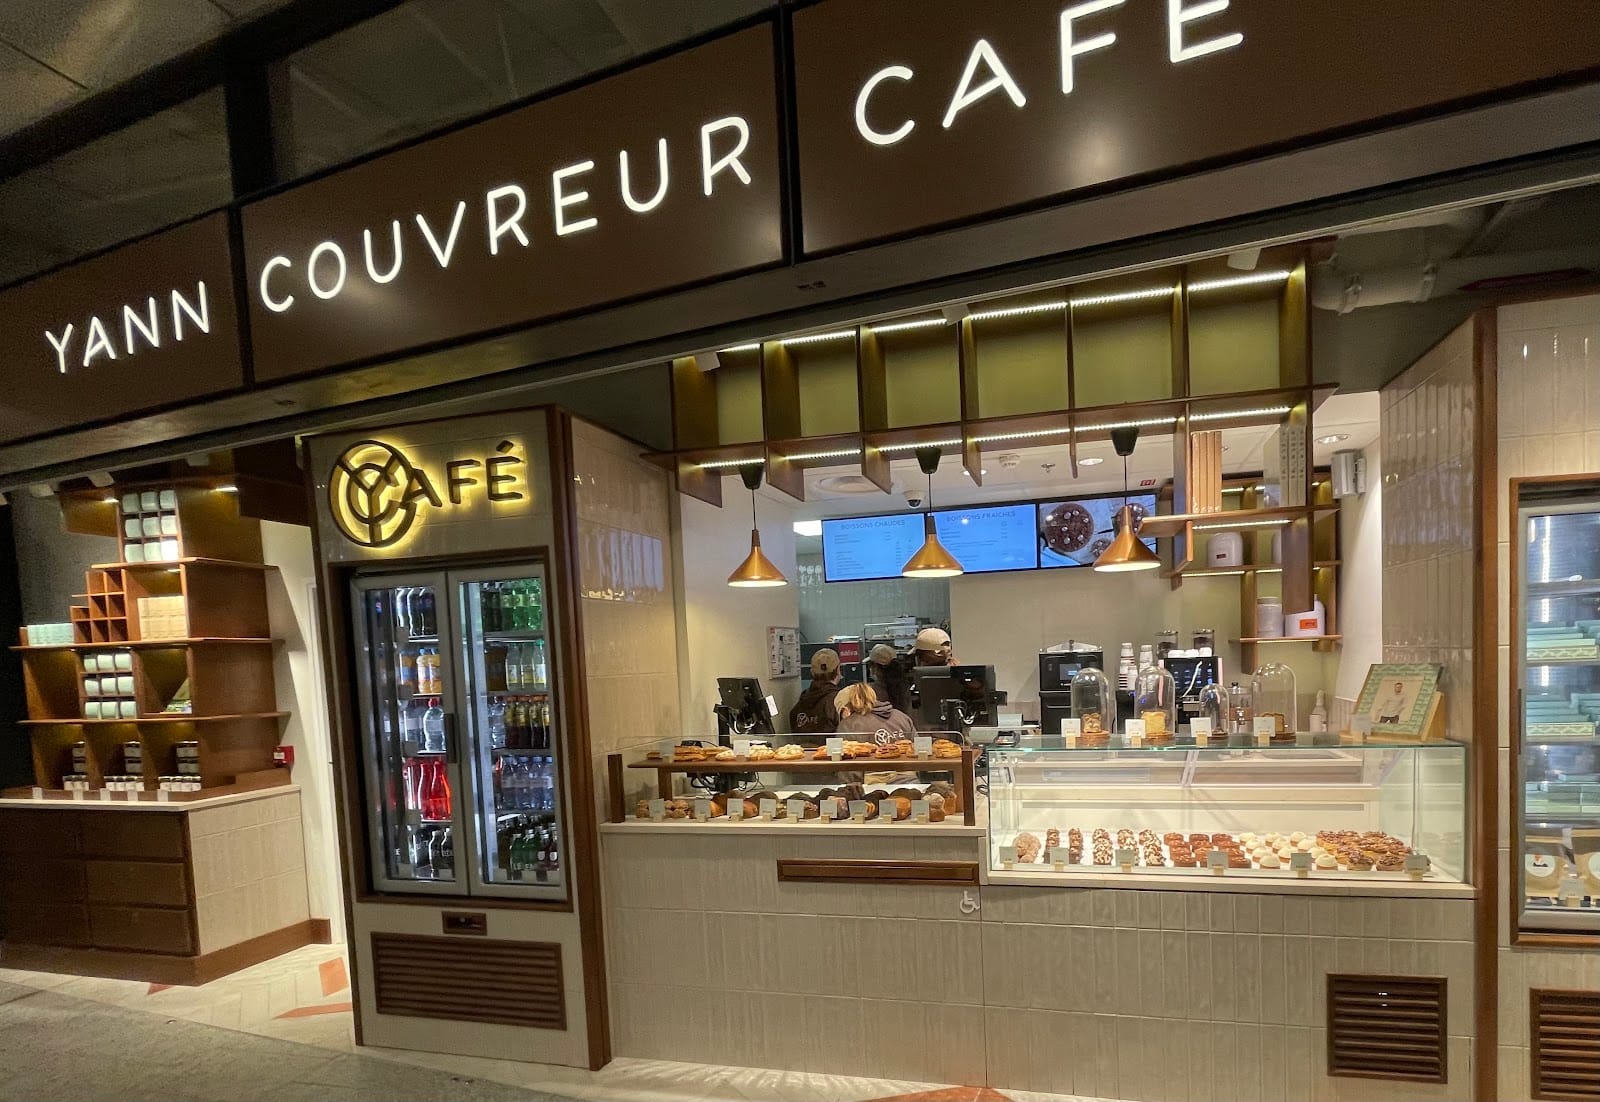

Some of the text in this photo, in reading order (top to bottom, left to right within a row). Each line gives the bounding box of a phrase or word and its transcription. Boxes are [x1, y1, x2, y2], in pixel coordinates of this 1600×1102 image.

[45, 279, 212, 375] YANN
[259, 115, 753, 314] COUVREUR
[946, 513, 981, 522] BOISSONS
[840, 519, 906, 531] BOISSONS CHAUDES
